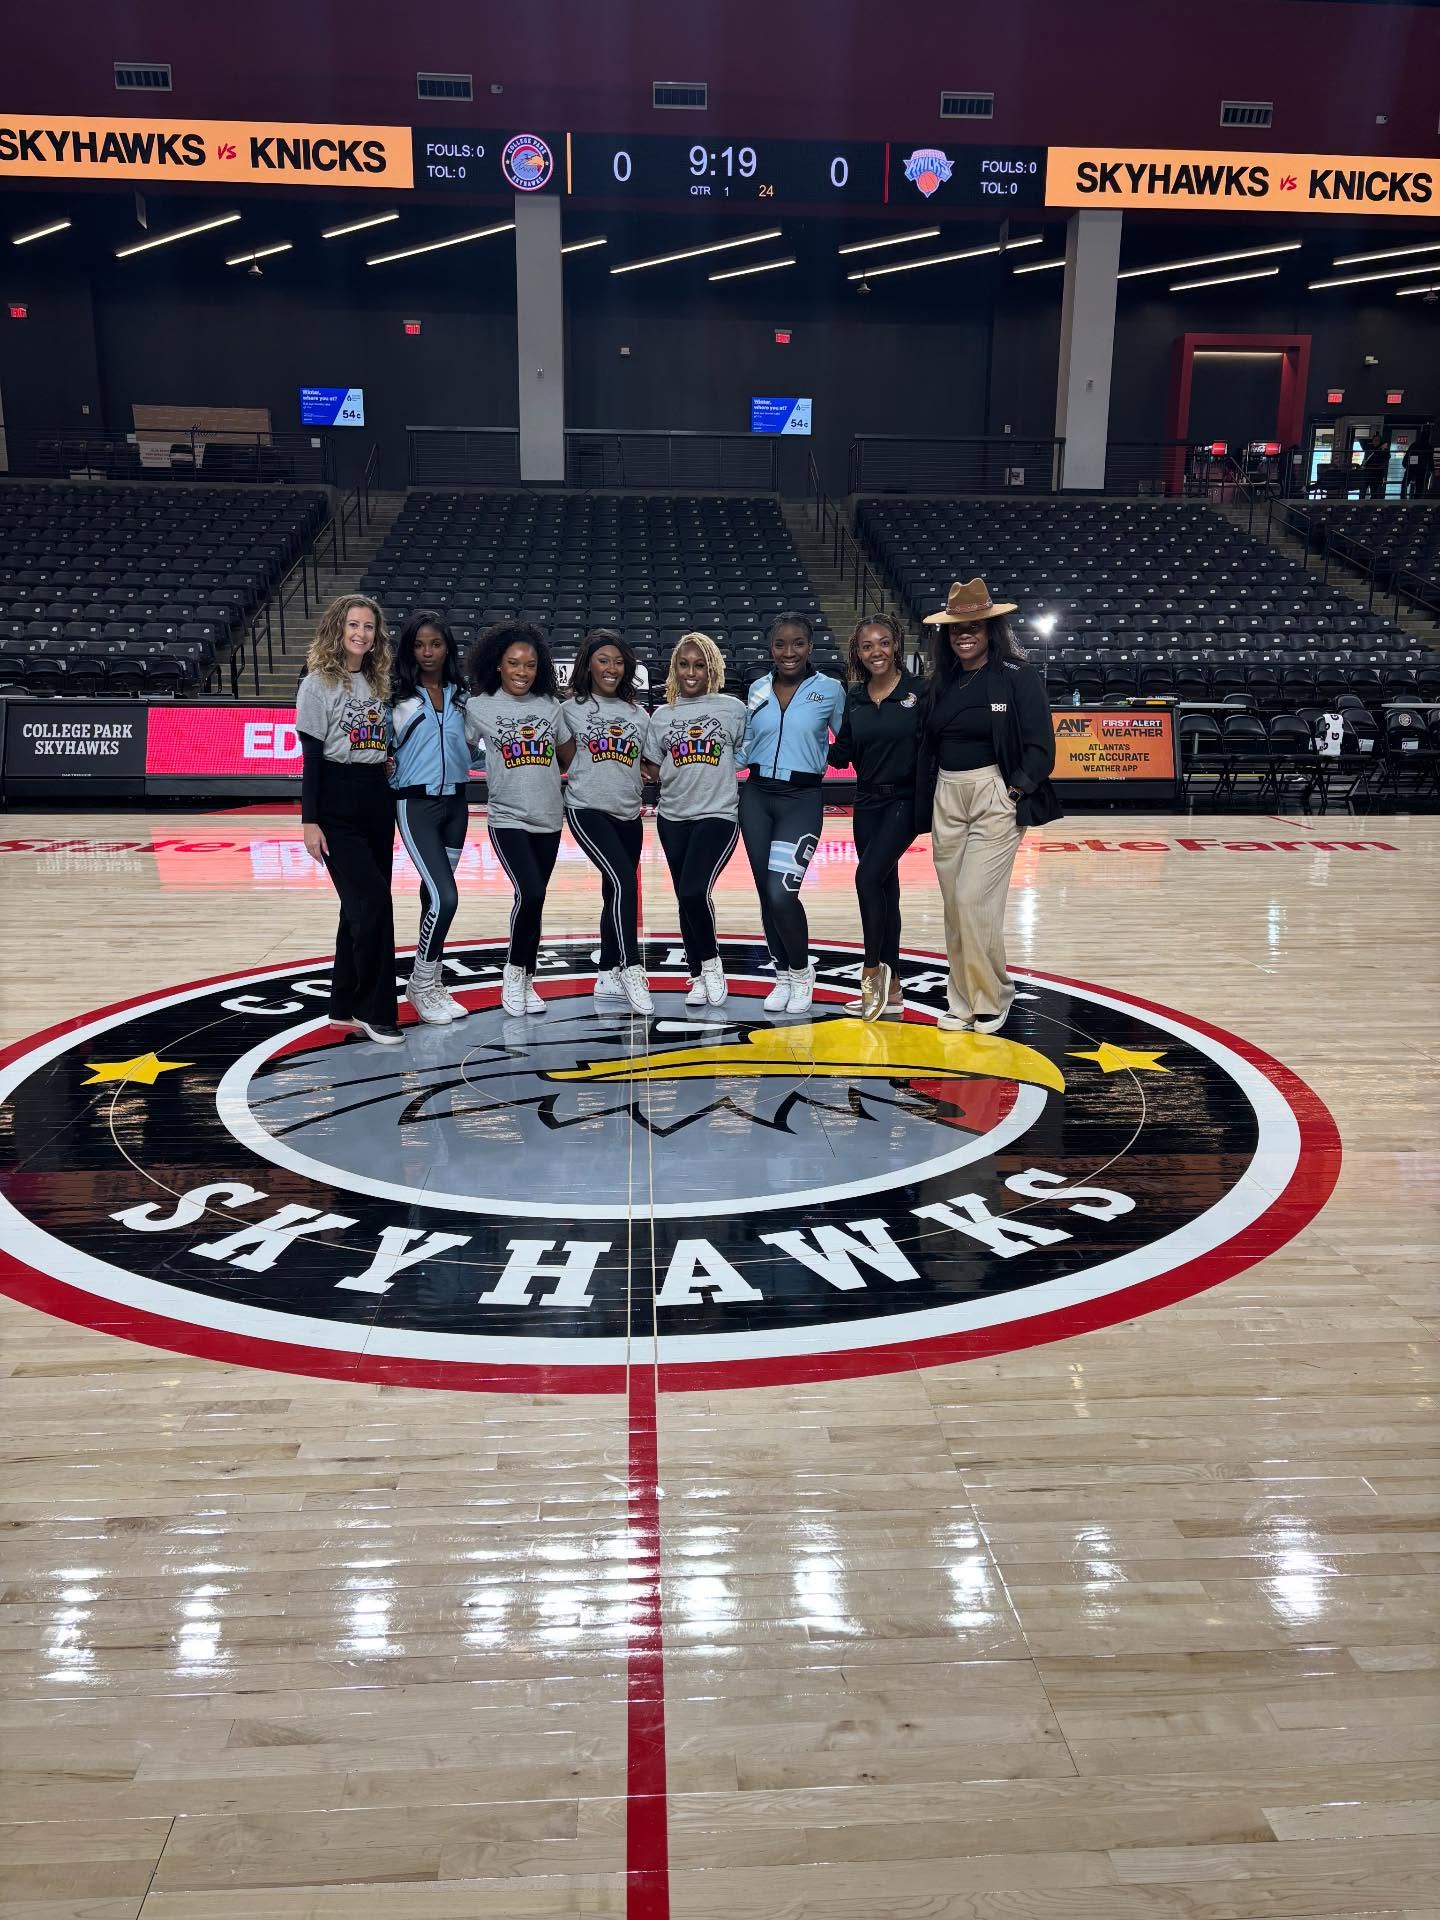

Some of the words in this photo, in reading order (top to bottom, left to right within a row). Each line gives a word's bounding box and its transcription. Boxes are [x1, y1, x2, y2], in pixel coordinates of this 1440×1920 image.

[0, 129, 206, 167] SKYHAWKS
[250, 137, 387, 174] KNICKS
[426, 143, 474, 158] FOULS:
[476, 145, 485, 158] 0
[507, 137, 532, 154] COLLEGE
[532, 139, 547, 154] PARK
[613, 151, 632, 182] 0
[689, 145, 757, 178] 9:19
[905, 156, 952, 180] KNICKS
[981, 160, 1027, 174] FOULS:
[1029, 162, 1037, 174] 0
[426, 165, 455, 178] TOL:
[458, 166, 466, 179] 0
[830, 157, 849, 188] 0
[511, 175, 544, 187] SKYHAWKS
[1076, 161, 1270, 197] SKYHAWKS
[1308, 168, 1433, 203] KNICKS
[690, 185, 711, 196] QTR
[759, 184, 774, 197] 24
[981, 182, 1009, 194] TOL:
[1010, 183, 1018, 195] 0
[343, 410, 355, 419] 54
[791, 418, 803, 427] 54
[990, 703, 1007, 712] 1881
[22, 723, 91, 738] COLLEGE
[93, 724, 133, 739] PARK
[1056, 719, 1092, 732] ANF
[1102, 728, 1163, 737] WEATHER
[1331, 732, 1340, 741] G
[34, 740, 120, 755] SKYHAWKS
[502, 740, 554, 759] COLLI'S
[588, 737, 638, 758] COLLI'S
[671, 739, 721, 758] COLLI'S
[506, 756, 551, 767] CLASSROOM
[674, 754, 719, 766] CLASSROOM
[1070, 753, 1095, 762] MOST
[1098, 753, 1150, 762] ACCURATE
[1083, 764, 1121, 772] WEATHER
[1175, 838, 1401, 851] Farm
[109, 1167, 1136, 1307] SKYHAWKS
